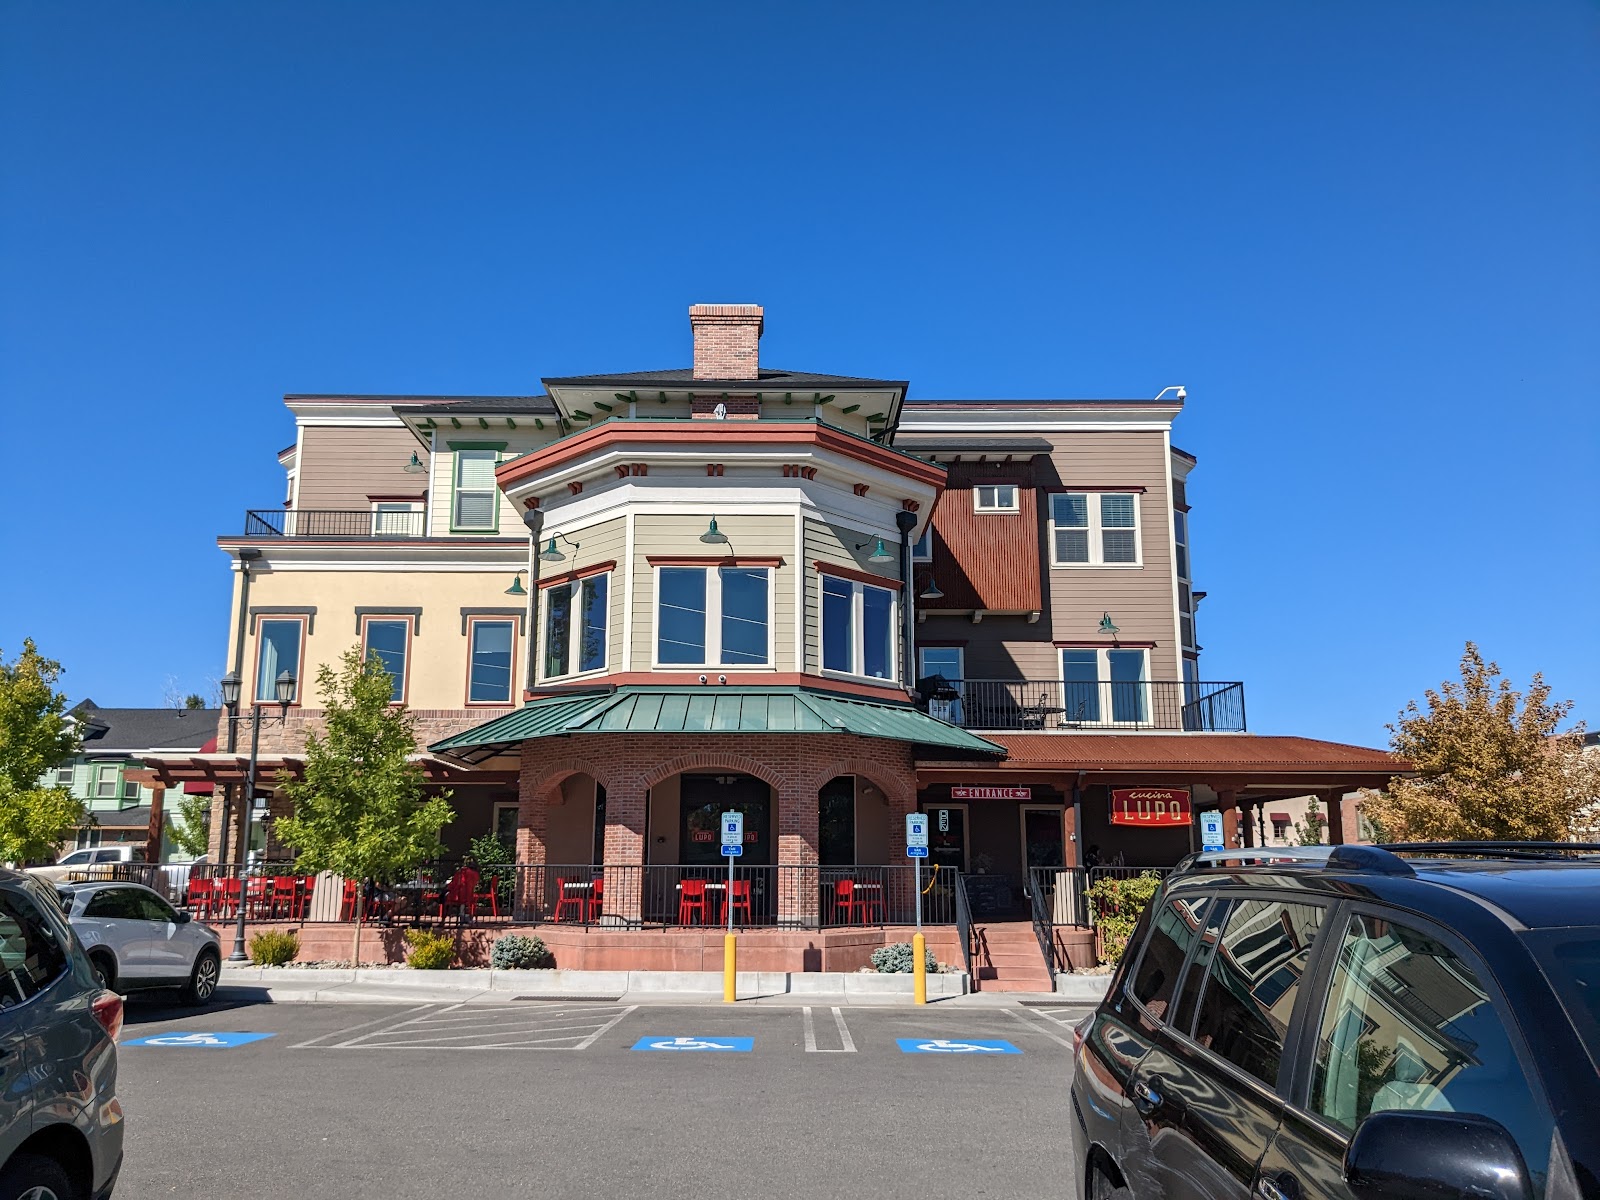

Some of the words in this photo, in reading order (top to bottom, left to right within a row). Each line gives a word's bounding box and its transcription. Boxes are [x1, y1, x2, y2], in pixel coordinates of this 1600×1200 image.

[969, 788, 1013, 798] ENTRANCE
[1129, 791, 1173, 799] cucina
[1123, 800, 1182, 821] LUPO
[695, 833, 712, 841] LUPO
